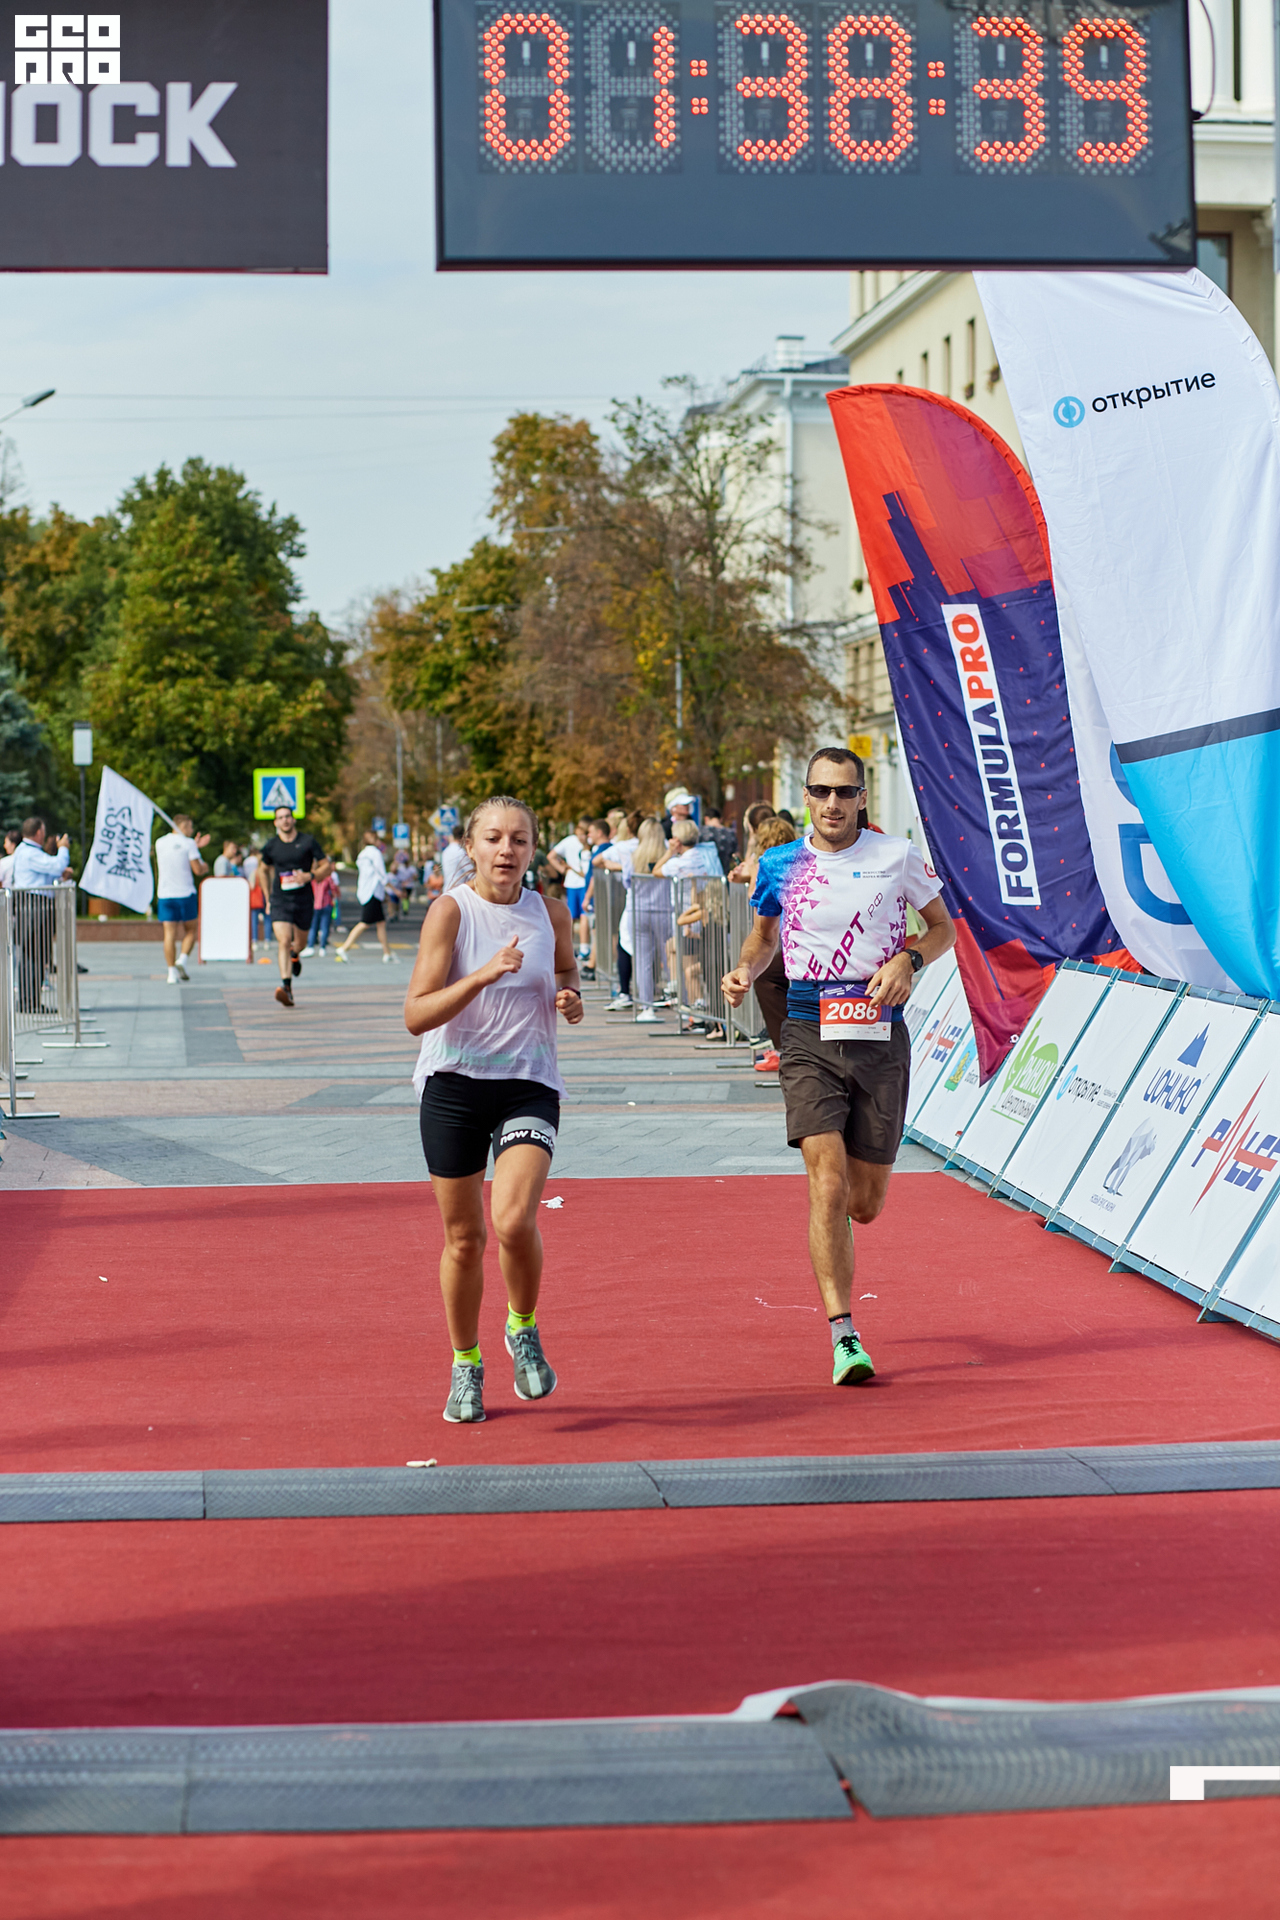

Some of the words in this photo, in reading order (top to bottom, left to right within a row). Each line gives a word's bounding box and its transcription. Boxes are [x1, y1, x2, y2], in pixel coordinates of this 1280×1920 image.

[482, 12, 1149, 165] 01:38:39
[1091, 371, 1216, 414] открытие
[825, 1002, 878, 1021] 2086
[1015, 1054, 1057, 1096] РЫНОК
[500, 1129, 529, 1146] new
